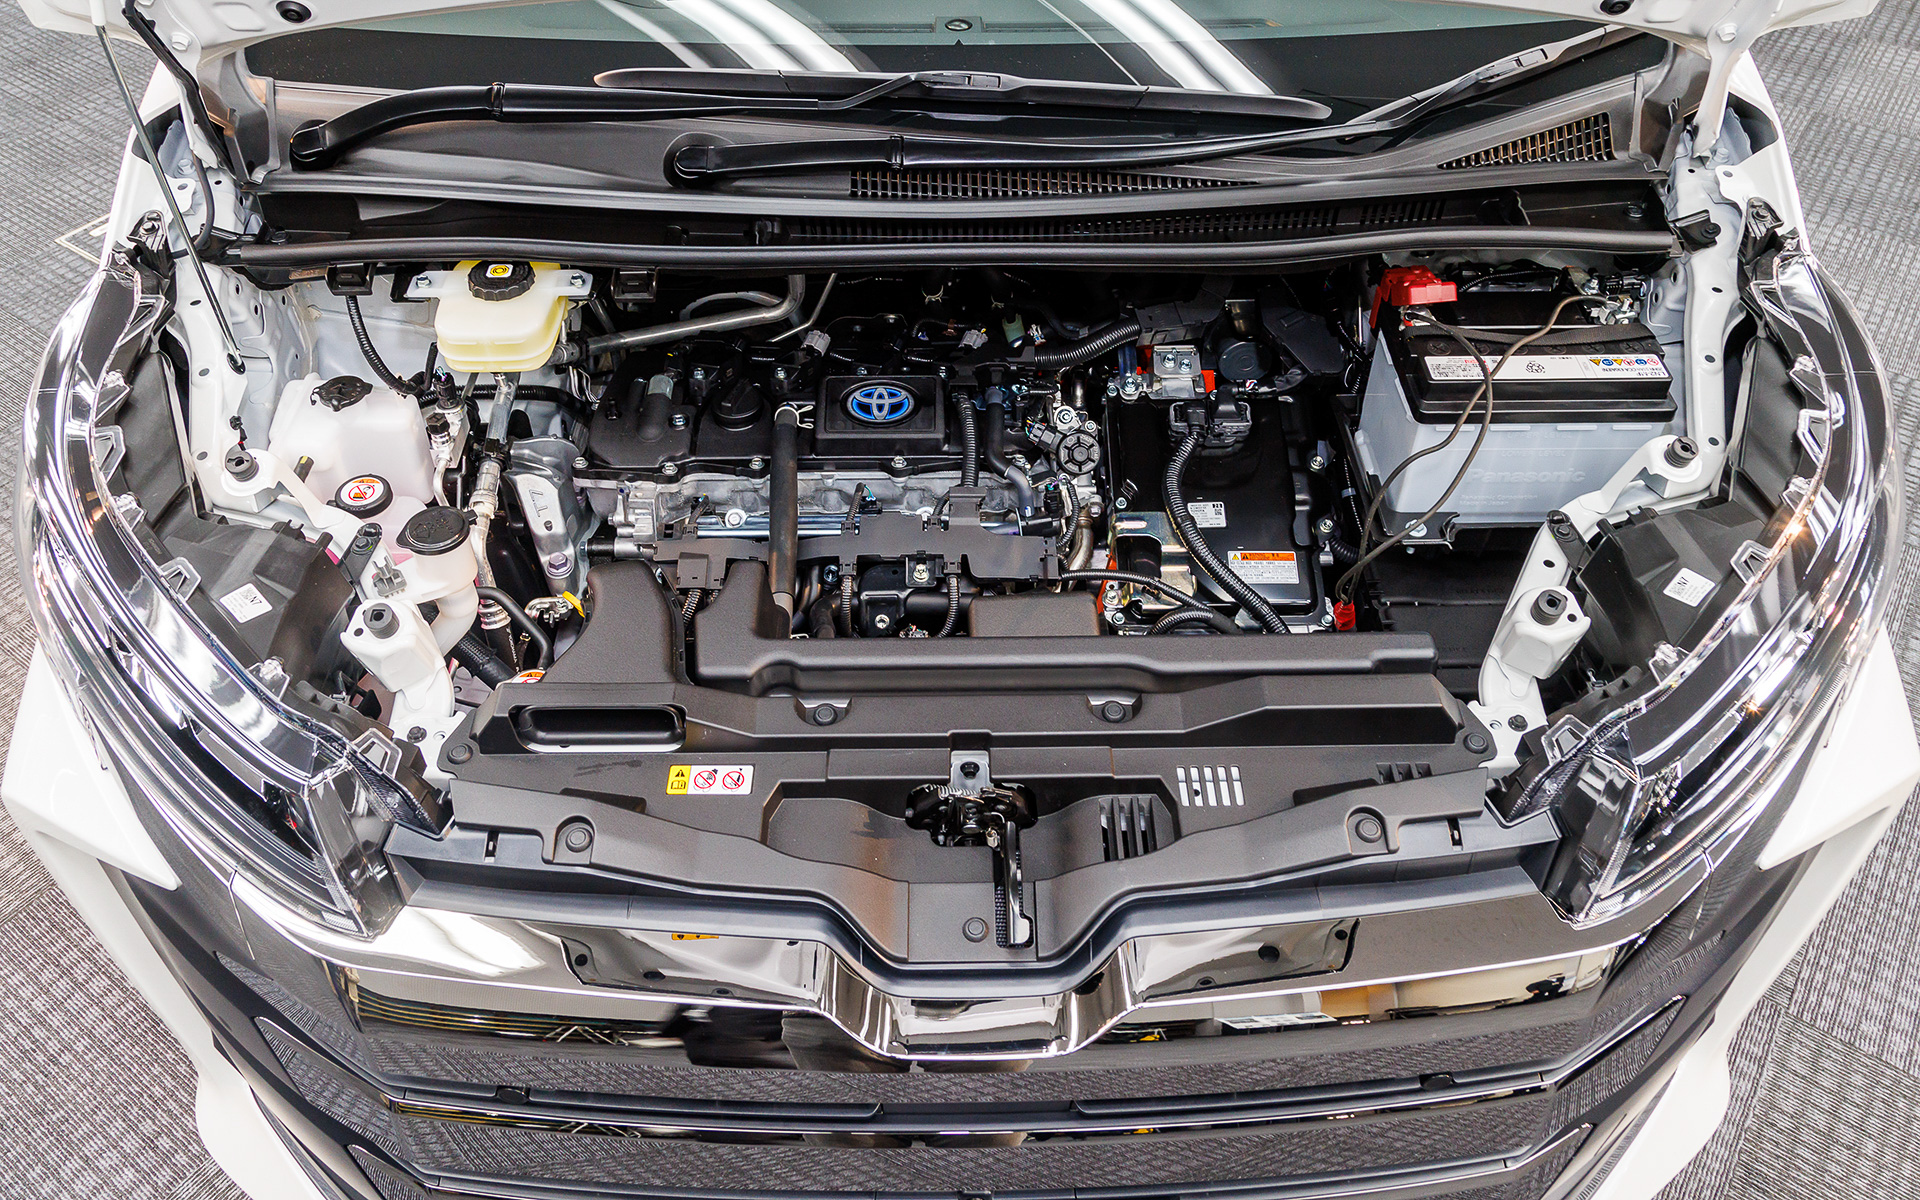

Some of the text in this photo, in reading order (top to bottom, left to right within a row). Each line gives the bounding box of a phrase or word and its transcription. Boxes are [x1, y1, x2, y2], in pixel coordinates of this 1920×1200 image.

[1544, 431, 1573, 439] LEVEL
[1538, 449, 1567, 457] LEVEL
[1466, 468, 1586, 483] Panasonic
